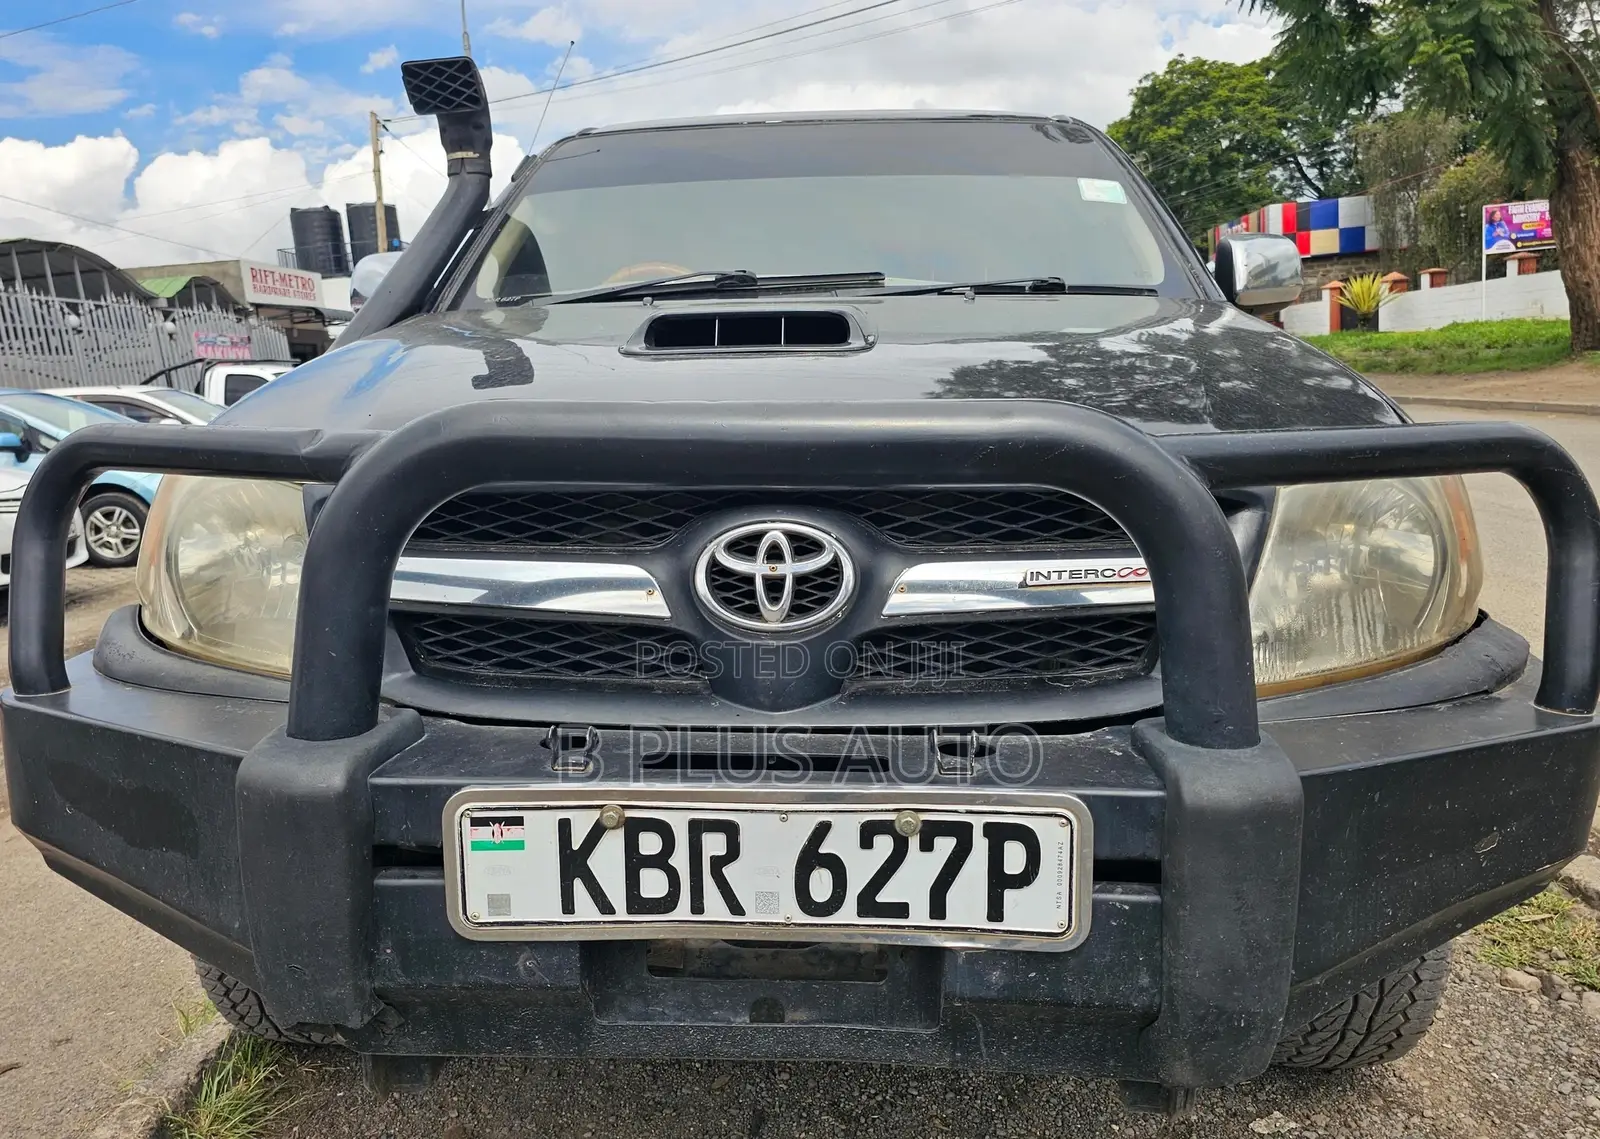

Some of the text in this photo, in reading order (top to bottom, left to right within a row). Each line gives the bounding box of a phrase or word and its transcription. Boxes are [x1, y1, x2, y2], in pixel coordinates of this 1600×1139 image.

[250, 267, 315, 291] RIFT-METRO
[252, 283, 291, 298] HARDWARE
[557, 816, 1041, 924] KBR 627P
